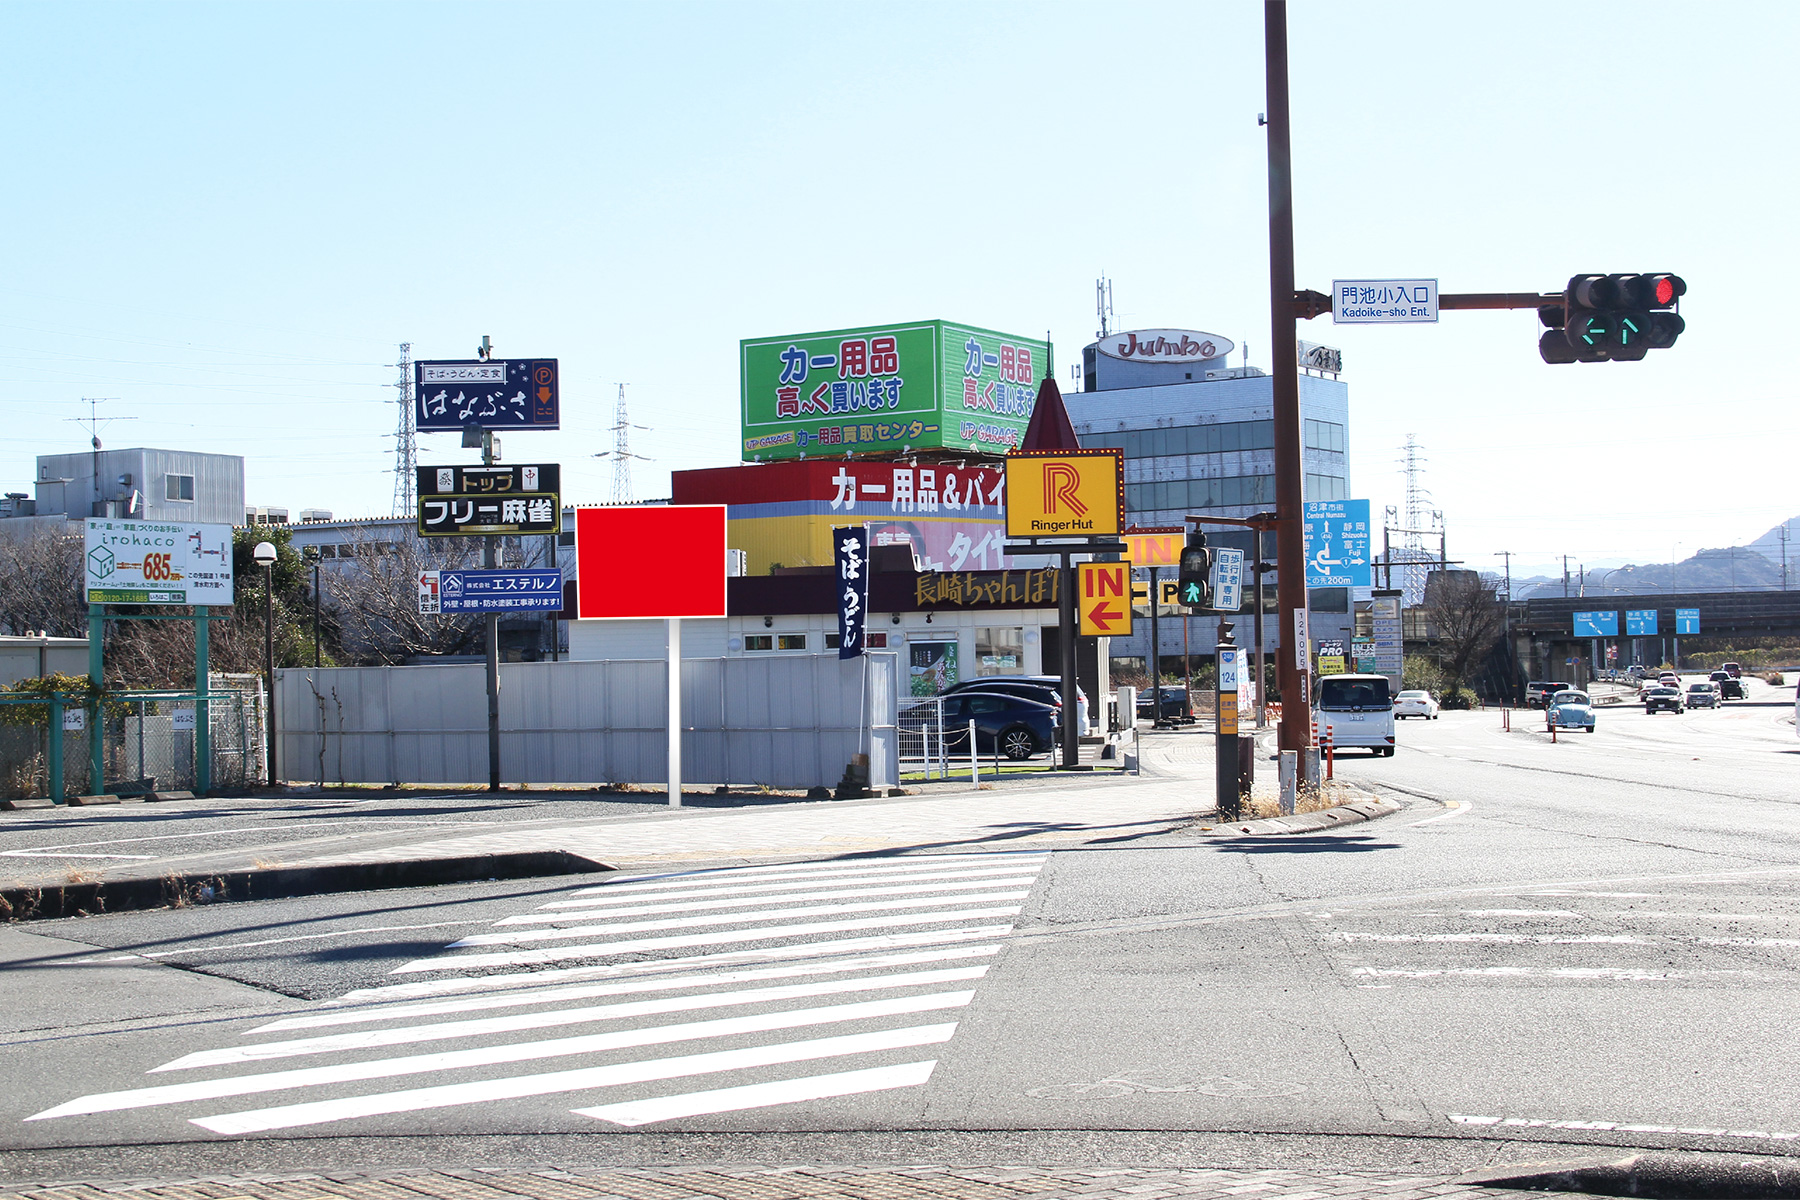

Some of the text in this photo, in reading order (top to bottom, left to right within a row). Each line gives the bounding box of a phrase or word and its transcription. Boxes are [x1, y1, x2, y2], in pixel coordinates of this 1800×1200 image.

[1342, 286, 1428, 304] 門池小入口
[1342, 307, 1429, 317] Kadoike-sho Ent.
[1118, 333, 1217, 357] Jumbo
[779, 336, 898, 384] カー用品
[965, 336, 1032, 385] カー用品
[427, 368, 501, 379] そば・うどん・定食
[422, 389, 526, 421] はなぶさ
[746, 433, 793, 449] UP GARAGE
[796, 420, 939, 447] カー用品買取センター
[960, 420, 1018, 445] UP GARAGE
[462, 475, 513, 492] トップ
[525, 469, 535, 486] 中
[1043, 463, 1089, 518] R
[425, 499, 552, 525] フリー麻雀
[1309, 503, 1344, 511] 沼津市街
[1031, 520, 1094, 532] Ringer Hut
[1343, 522, 1365, 531] 静岡
[102, 533, 175, 547] irohaco
[1343, 540, 1365, 549] 富士
[1134, 537, 1171, 564] IN
[143, 552, 172, 581] 685
[1219, 554, 1229, 583] 自転車
[1229, 554, 1240, 585] 歩行者
[493, 578, 557, 590] エステルノ
[1085, 568, 1123, 598] IN
[421, 594, 439, 602] 信号
[840, 537, 862, 648] そば・うどん
[1222, 586, 1233, 605] 専用
[1319, 647, 1343, 656] PRO
[1221, 672, 1235, 683] 124
